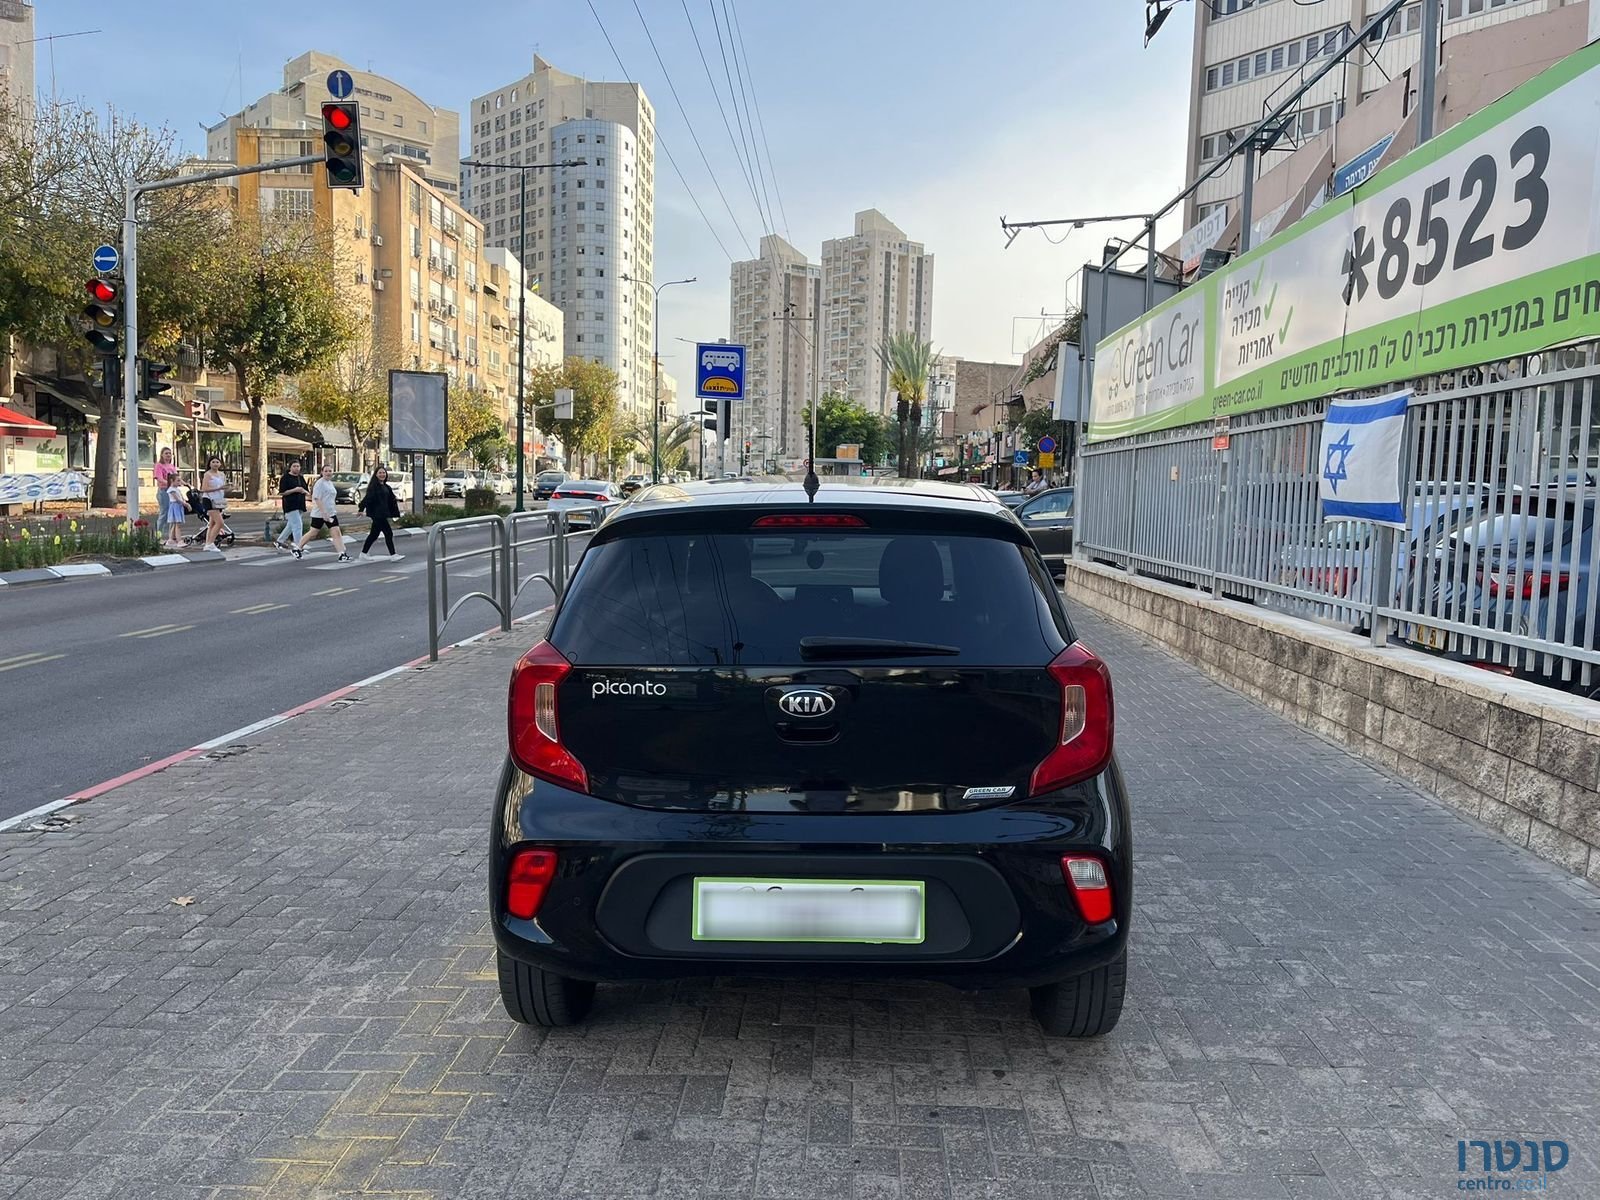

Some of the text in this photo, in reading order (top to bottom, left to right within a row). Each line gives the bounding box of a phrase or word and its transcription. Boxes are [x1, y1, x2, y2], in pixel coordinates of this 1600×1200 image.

[1197, 214, 1220, 244] דפוס
[1225, 280, 1250, 310] קנייה
[1232, 306, 1261, 337] מכירה
[1461, 297, 1544, 347] במכירת
[1123, 312, 1199, 389] Green Car
[1238, 333, 1274, 366] אחריות
[1402, 330, 1413, 361] 0
[1417, 322, 1456, 357] רכבי
[1280, 361, 1318, 390] חדשים
[1321, 348, 1364, 380] ורכבים
[1212, 379, 1263, 413] green-car.co.il
[592, 680, 667, 699] picanto
[788, 696, 827, 712] KIA
